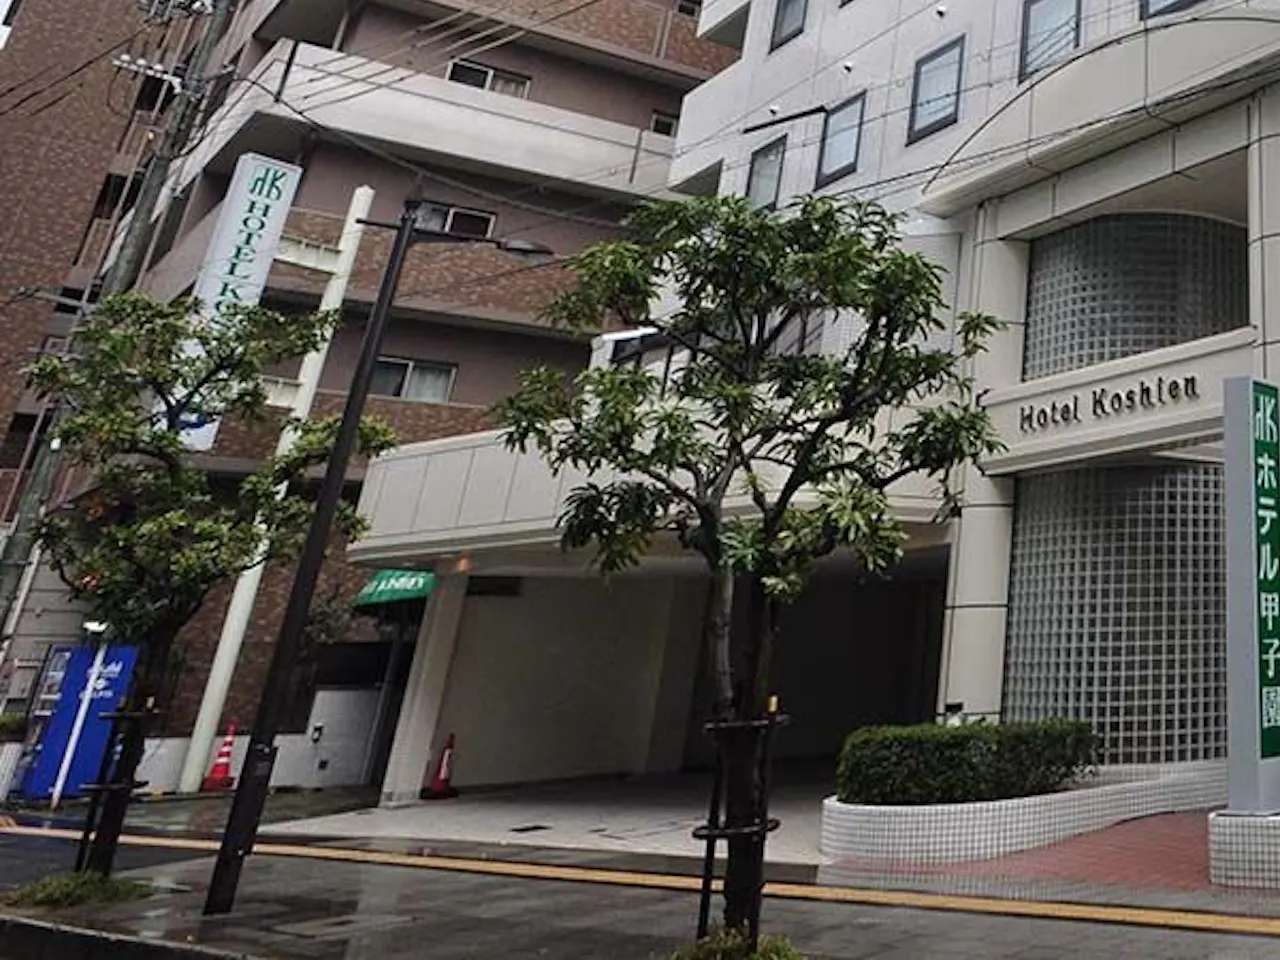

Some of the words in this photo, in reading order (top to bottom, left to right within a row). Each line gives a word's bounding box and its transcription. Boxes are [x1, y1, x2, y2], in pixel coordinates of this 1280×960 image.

[227, 201, 271, 280] HOTEL
[1020, 394, 1081, 433] Hotel
[1092, 375, 1200, 417] Koshien
